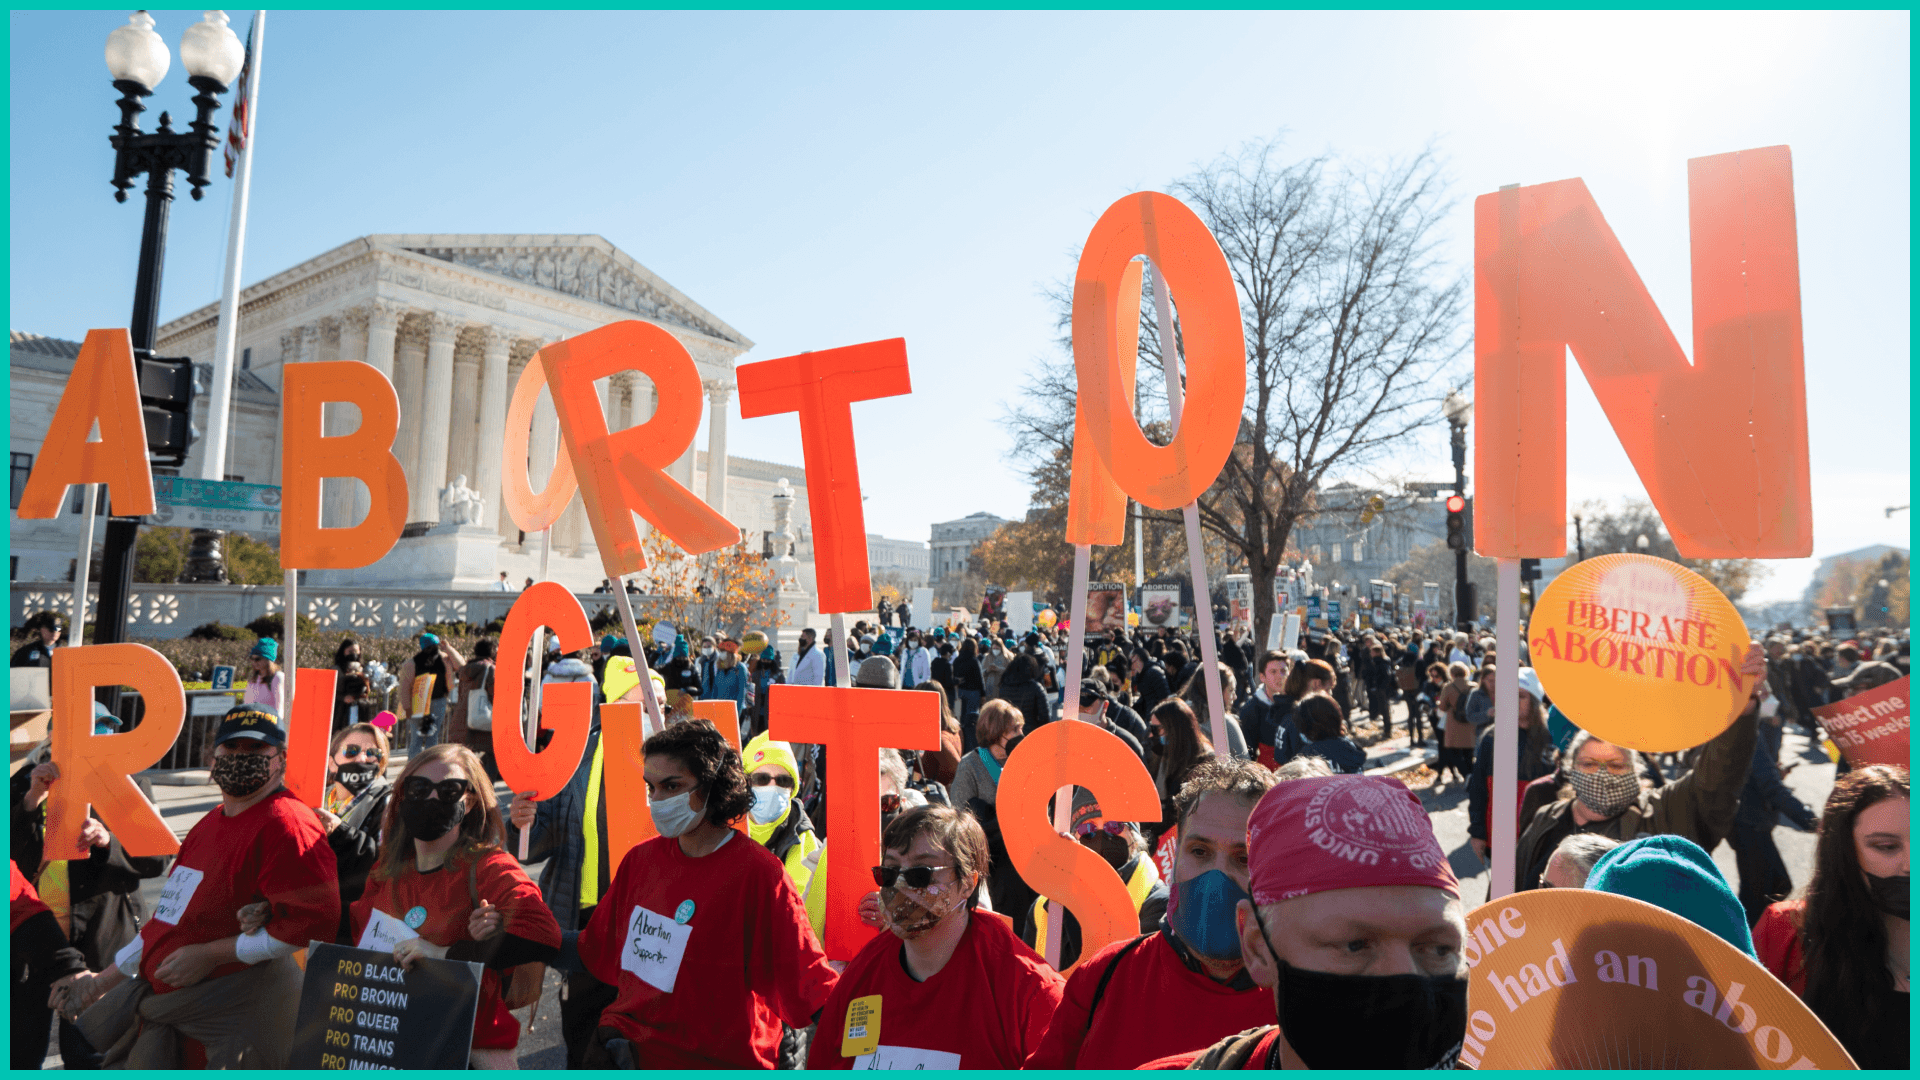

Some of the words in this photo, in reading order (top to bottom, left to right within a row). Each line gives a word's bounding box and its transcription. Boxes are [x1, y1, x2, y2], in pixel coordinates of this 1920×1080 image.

[201, 513, 247, 524] BLOCKS
[1089, 583, 1123, 591] BORTION
[1566, 599, 1718, 651] LIBERATE
[1531, 627, 1743, 693] ABORTION
[225, 710, 278, 725] ABORTION
[1870, 696, 1906, 717] me
[241, 718, 258, 726] AF
[1845, 729, 1866, 745] 15
[342, 769, 374, 783] VOTE
[1308, 827, 1379, 866] UNION
[632, 910, 672, 944] Abortion
[1465, 906, 1526, 968] one
[337, 959, 362, 977] PRO
[364, 963, 405, 983] BLACK
[1486, 937, 1578, 1013] had
[1593, 949, 1659, 991] an
[333, 982, 358, 1000] PRO
[360, 986, 408, 1010] BROWN
[329, 1005, 354, 1023] PRO
[356, 1010, 400, 1034] QUEER
[325, 1029, 350, 1047] PRO
[352, 1033, 395, 1057] TRANS
[321, 1053, 346, 1070] PRO
